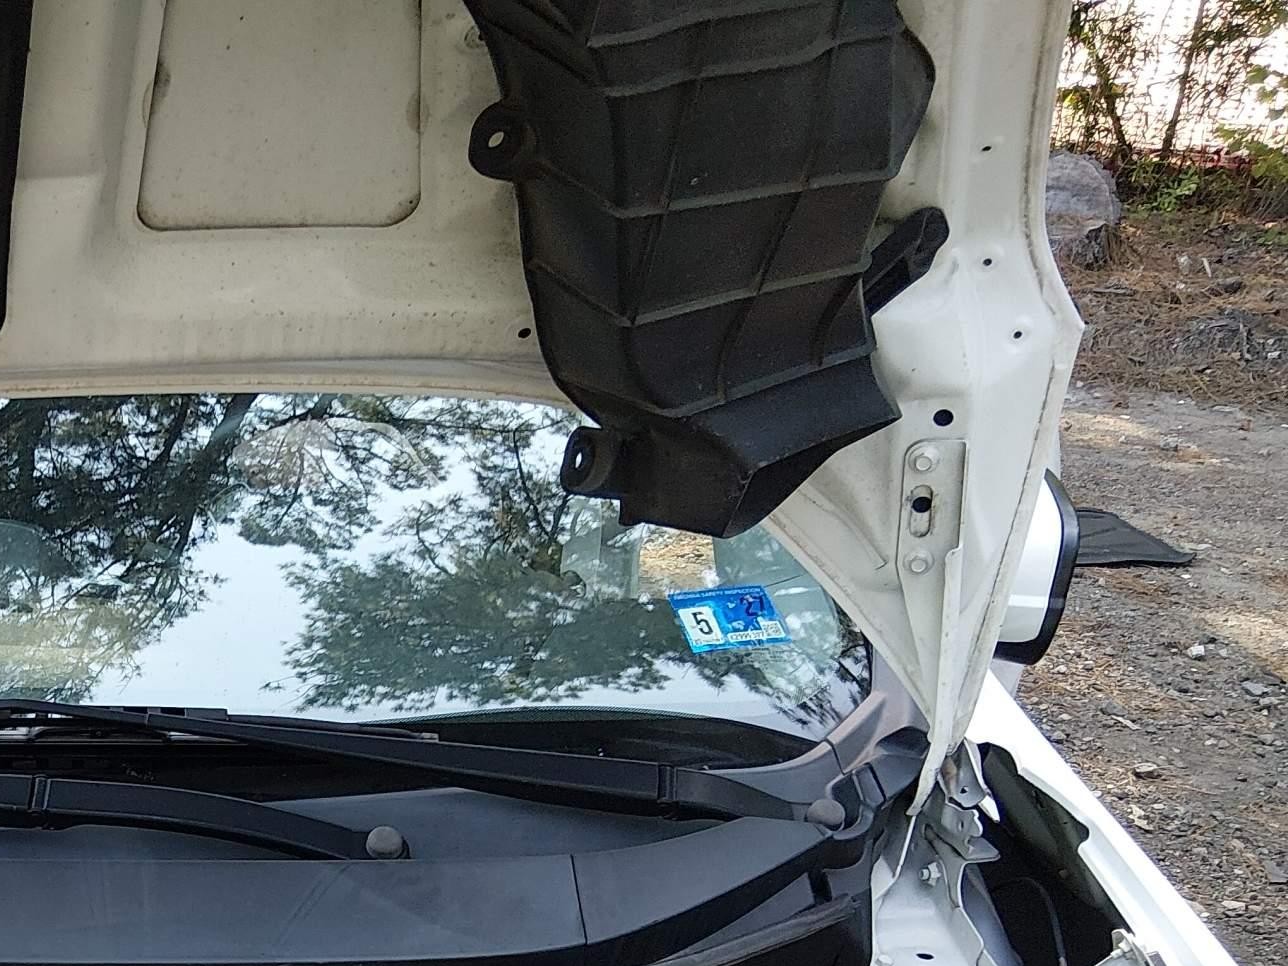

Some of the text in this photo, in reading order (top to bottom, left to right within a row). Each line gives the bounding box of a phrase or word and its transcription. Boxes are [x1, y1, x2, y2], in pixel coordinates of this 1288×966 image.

[724, 587, 762, 596] INSPECTION
[739, 594, 765, 617] 27
[691, 611, 714, 635] 5
